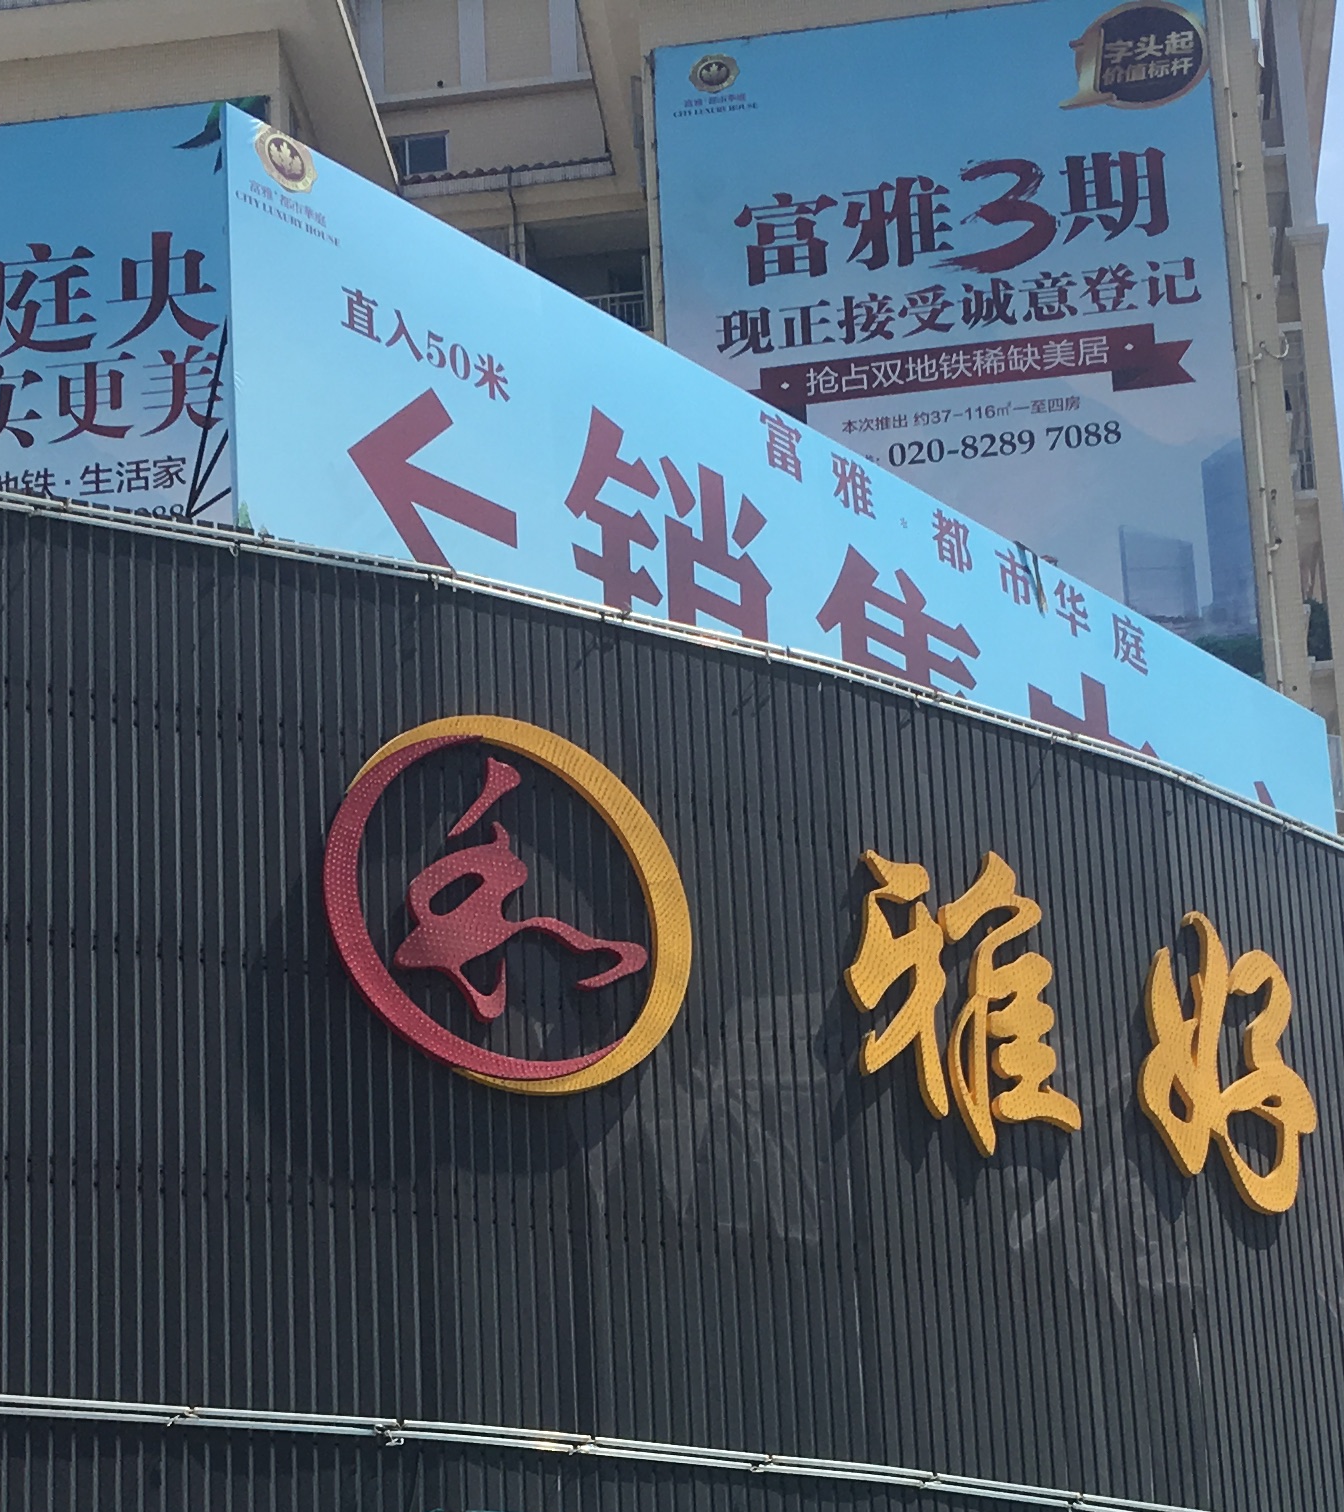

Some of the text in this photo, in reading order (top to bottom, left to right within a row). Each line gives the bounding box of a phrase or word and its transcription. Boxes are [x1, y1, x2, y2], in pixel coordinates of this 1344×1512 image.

[1102, 57, 1194, 86] 价值标杆
[235, 190, 341, 247] CITY LUXURY HOUSE
[734, 147, 1170, 287] 富雅3期
[715, 257, 1202, 359] 现正接受诚意登记
[340, 287, 511, 402] 直入50米
[805, 338, 1109, 397] 抢占双地铁稀缺美居
[842, 414, 908, 434] 本次推出
[888, 420, 1122, 467] 020-8289 7088
